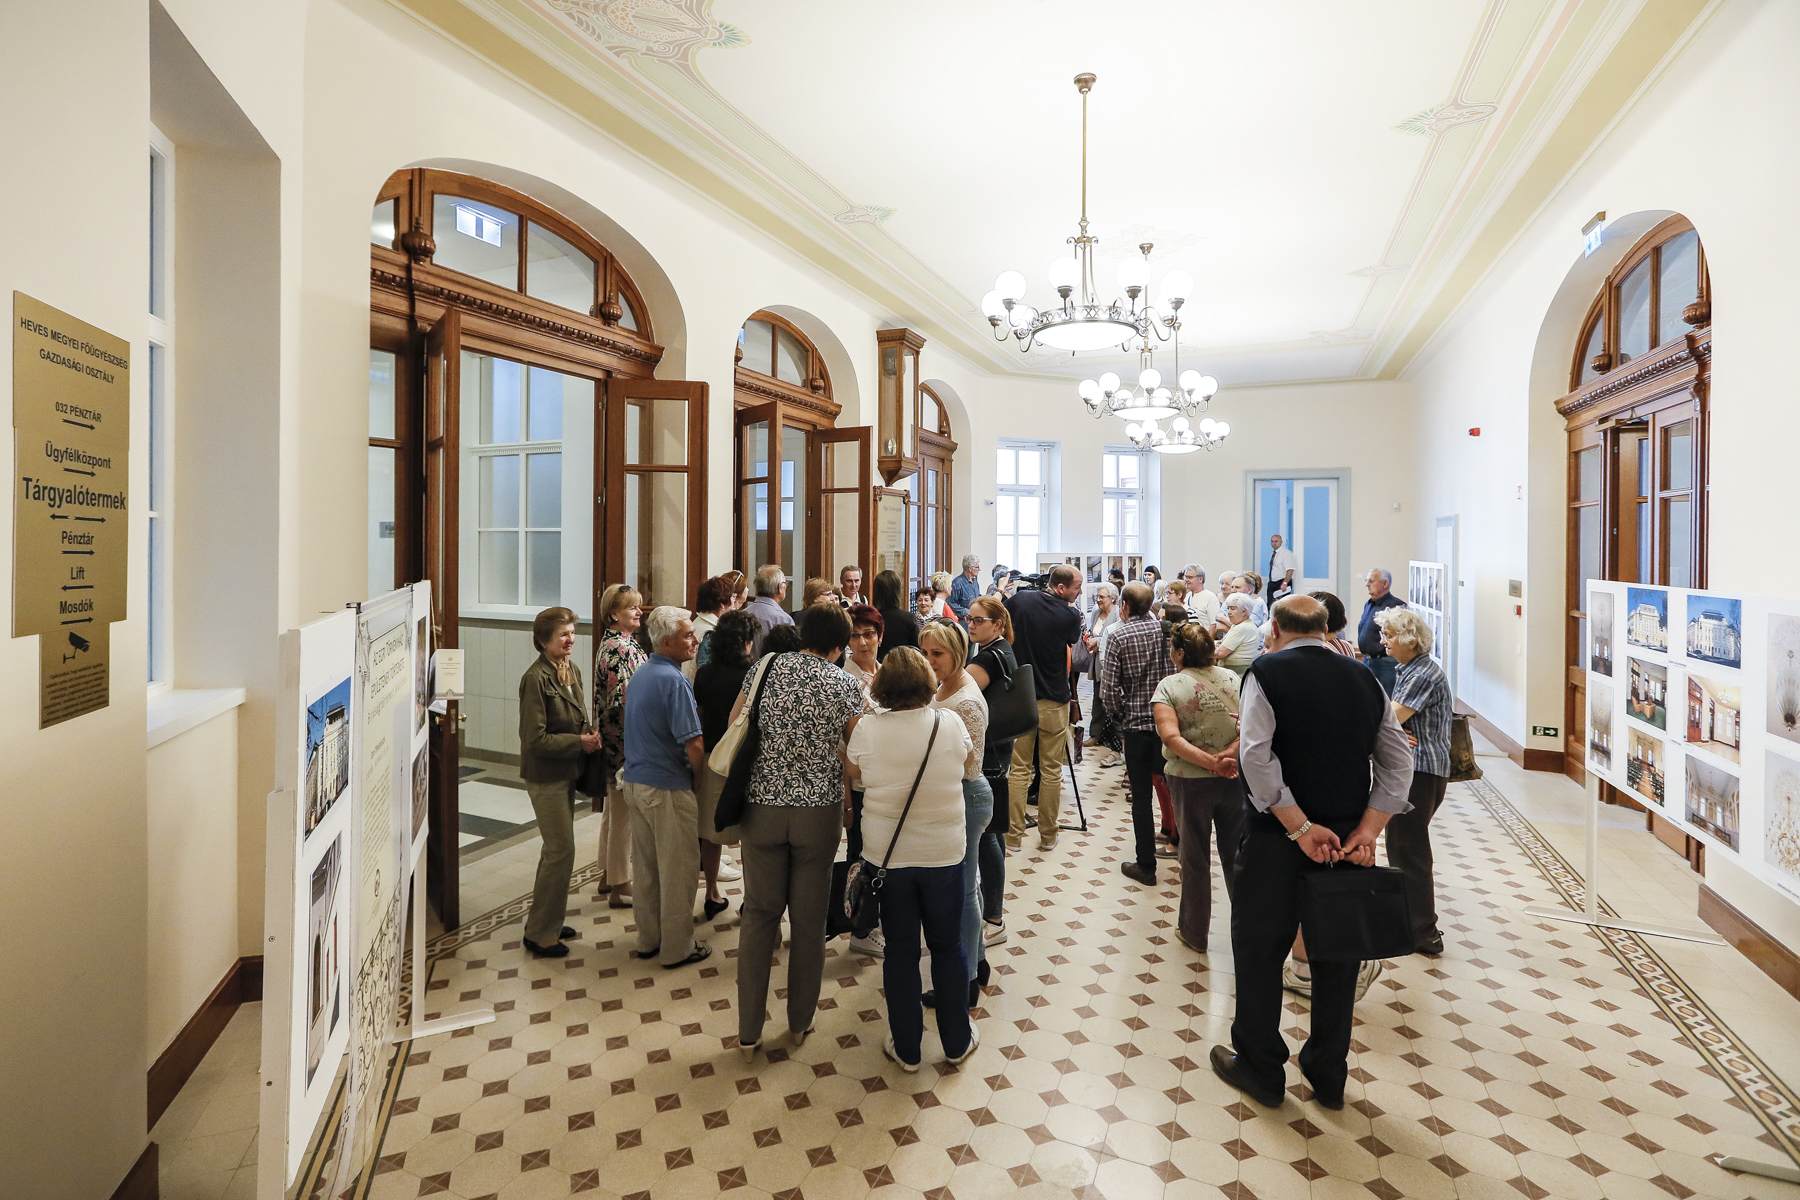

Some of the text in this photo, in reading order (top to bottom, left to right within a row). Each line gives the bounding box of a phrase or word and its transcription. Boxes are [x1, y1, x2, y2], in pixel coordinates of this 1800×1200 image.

[20, 317, 128, 370] HEVES MEGYEI FŐÜGYÉSZSÉG
[39, 348, 115, 384] GAZDASÁGI OSZTÁLY
[55, 401, 102, 423] 032 PÉNZTÁR
[45, 440, 112, 470] Ügyfélközpont
[22, 476, 127, 511] Tárgyalótermek
[61, 530, 95, 546] Pénztár
[70, 566, 86, 580] Lift
[59, 599, 94, 615] Mosdók
